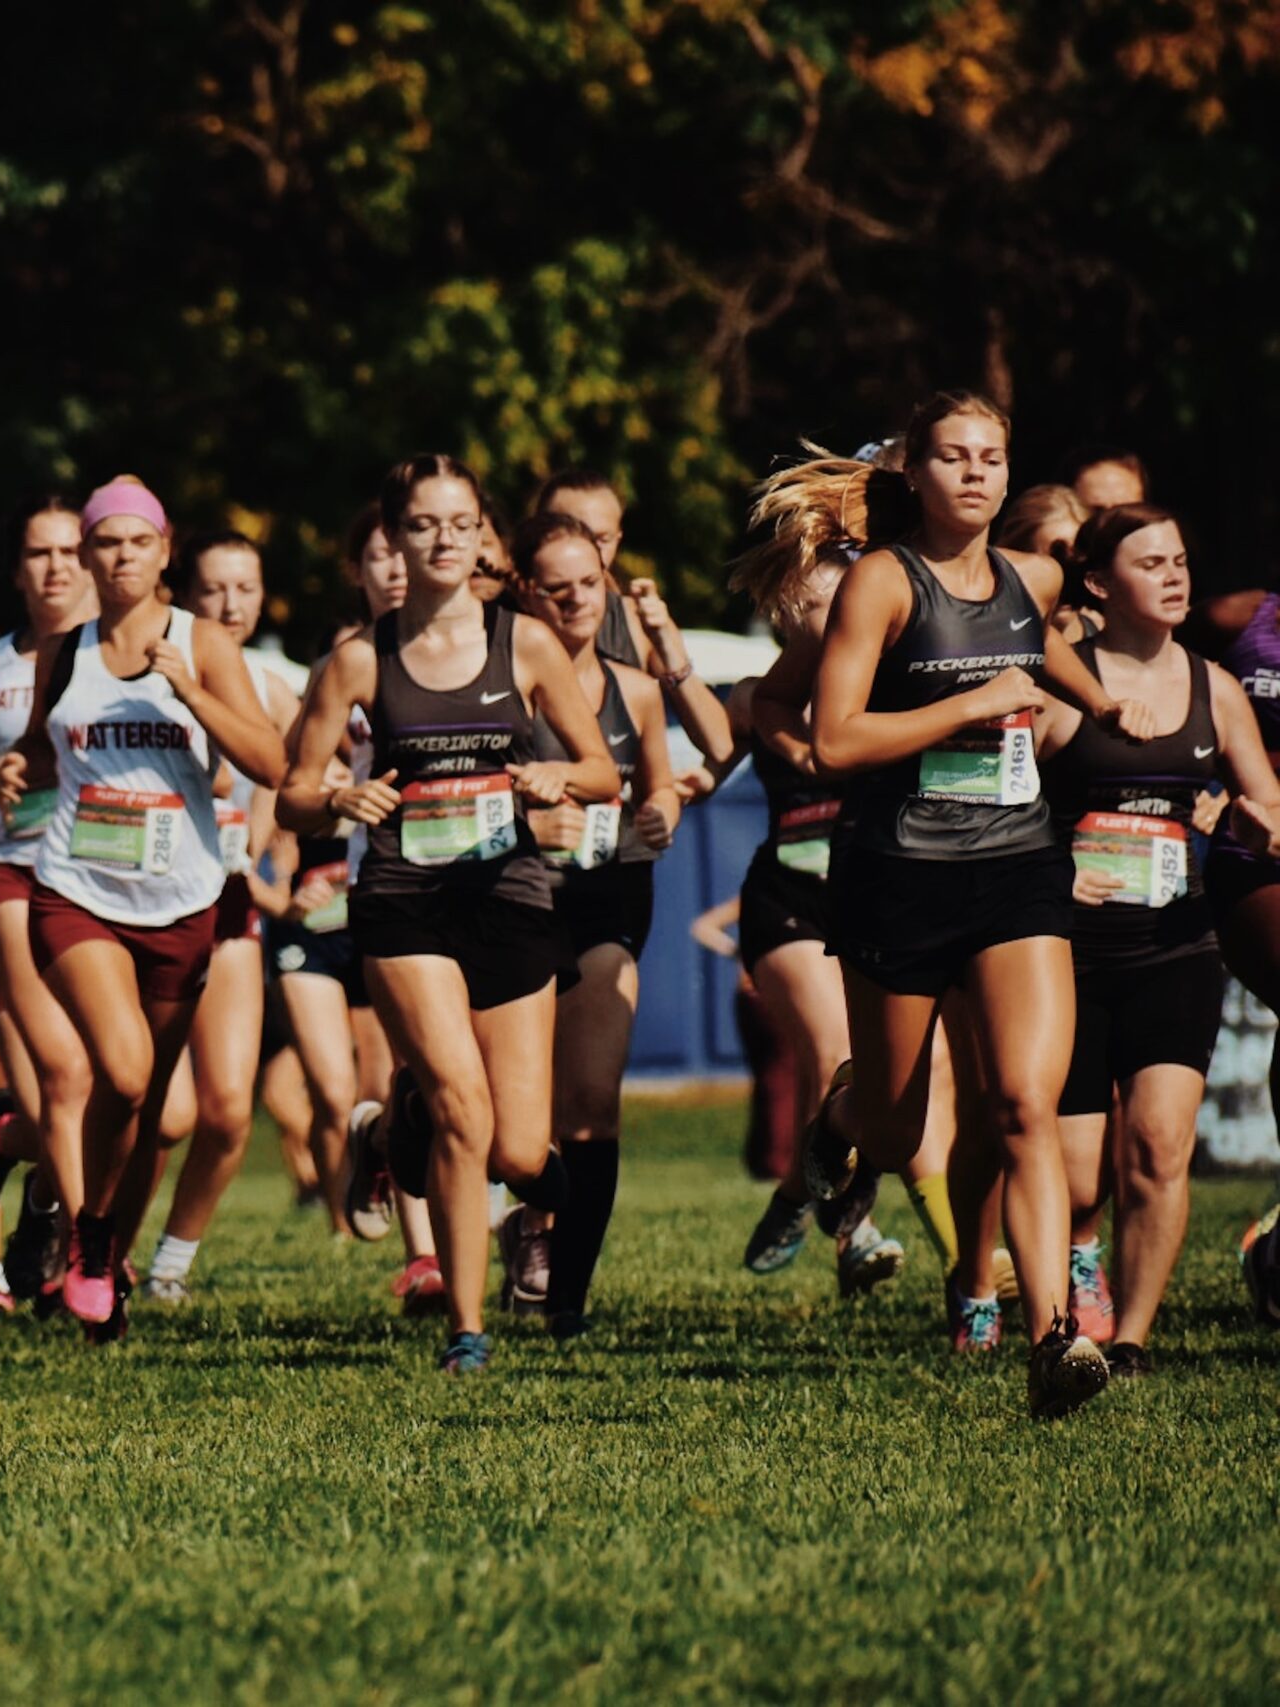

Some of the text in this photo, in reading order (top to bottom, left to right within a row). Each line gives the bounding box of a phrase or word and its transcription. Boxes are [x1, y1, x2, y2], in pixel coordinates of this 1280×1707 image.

[1010, 733, 1032, 794] 2469
[153, 812, 174, 866] 2846
[1160, 843, 1179, 898] 2452
